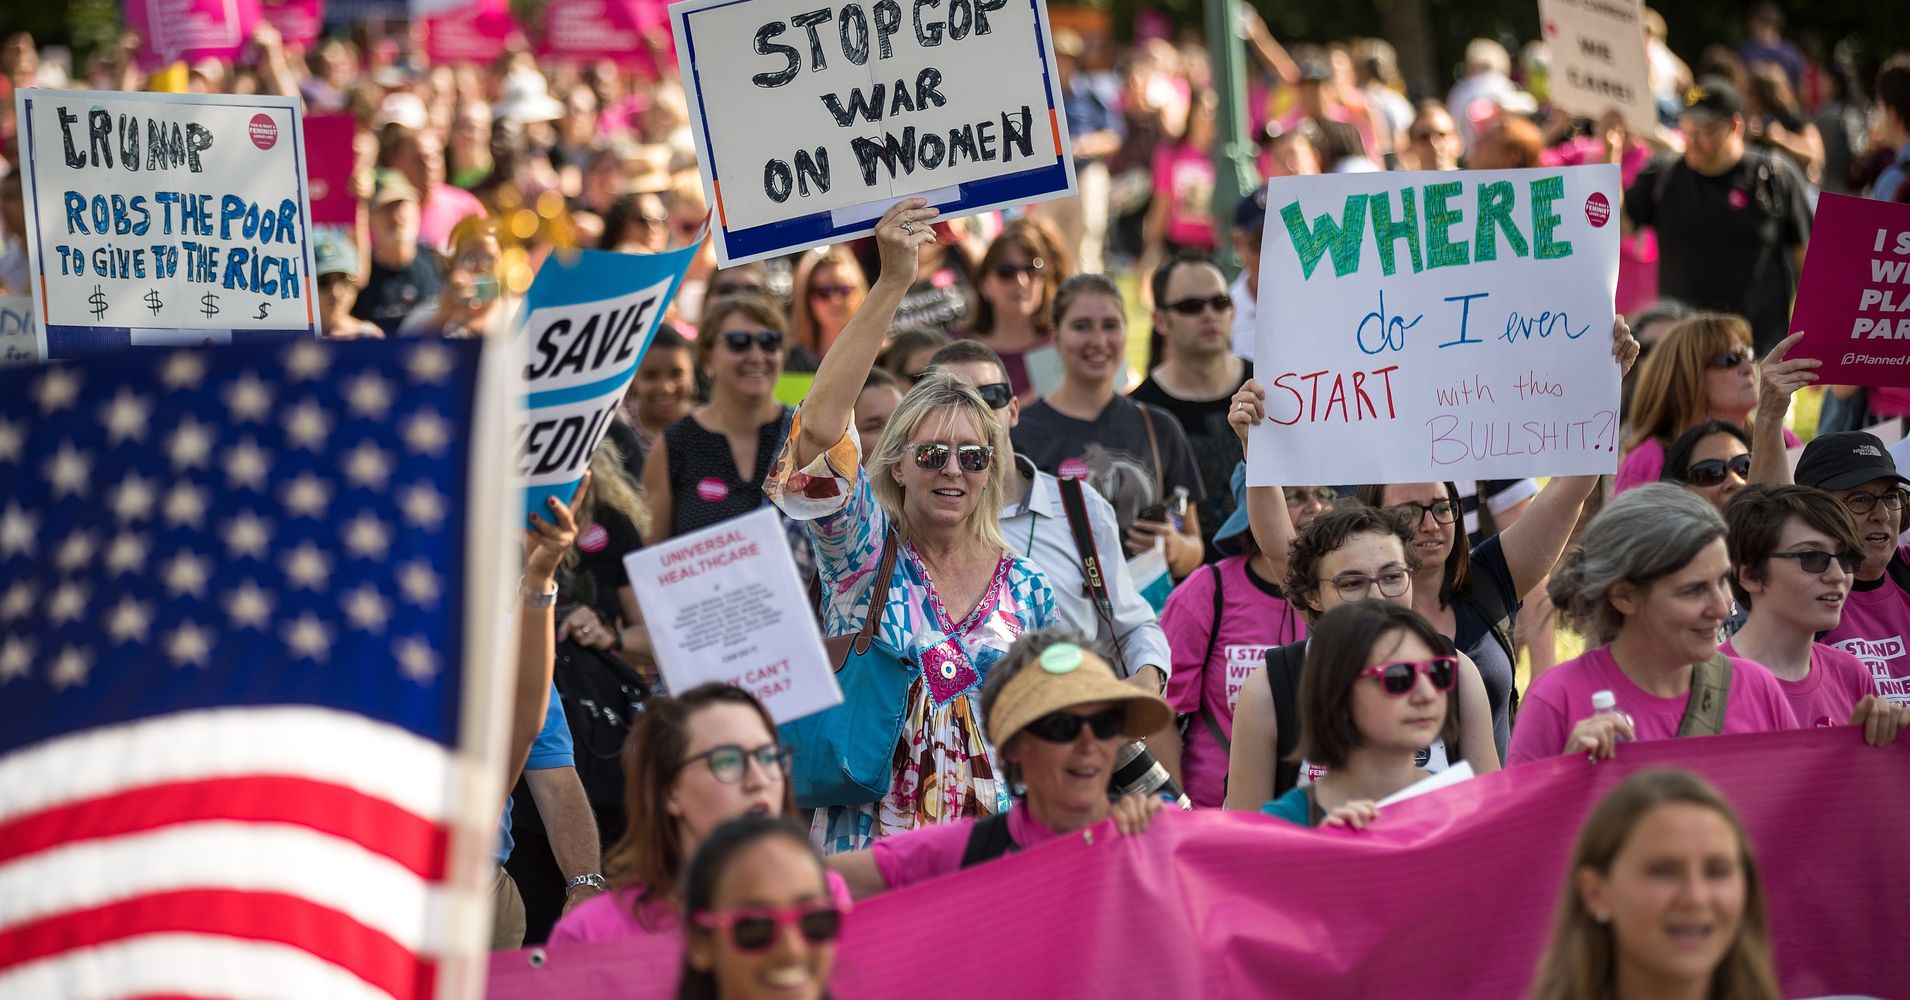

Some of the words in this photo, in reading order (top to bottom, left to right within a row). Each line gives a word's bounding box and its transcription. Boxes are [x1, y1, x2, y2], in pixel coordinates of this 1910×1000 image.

[752, 0, 902, 88] STOP
[819, 67, 947, 127] WAR
[249, 127, 278, 136] FEMINIST
[764, 146, 831, 203] ON
[851, 105, 1035, 186] WOMEN
[64, 191, 151, 236] ROBS
[155, 191, 214, 236] THE
[220, 194, 297, 244] POOR
[1280, 175, 1574, 280] WHERE
[1585, 204, 1610, 215] FEMINIST
[56, 246, 85, 276] TO
[151, 245, 178, 279] TO
[182, 241, 219, 283] THE
[1873, 228, 1888, 252] I
[521, 296, 657, 381] SAVE
[1357, 289, 1424, 355] do
[1439, 293, 1489, 349] I
[1498, 310, 1590, 343] even
[1855, 354, 1906, 365] Planned
[1269, 365, 1399, 425] START
[1436, 374, 1495, 406] with
[1513, 370, 1563, 397] this
[1426, 410, 1618, 468] BULLSHIT?!
[657, 543, 760, 587] HEALTHCARE
[660, 530, 747, 567] UNIVERSAL
[1085, 556, 1102, 587] EOS
[745, 658, 789, 684] CAN'T
[1845, 641, 1901, 657] STAND
